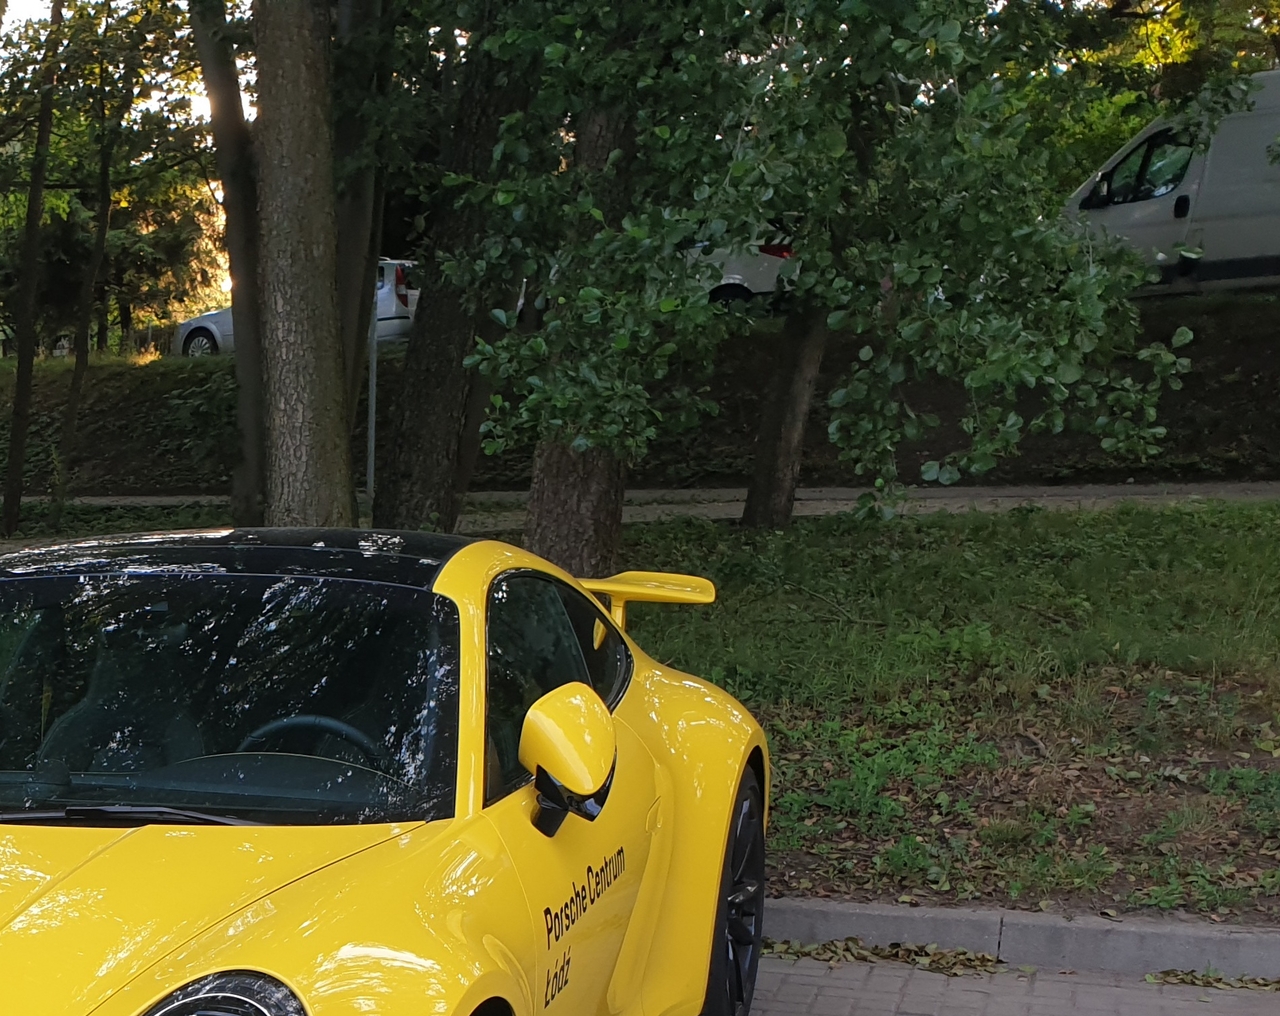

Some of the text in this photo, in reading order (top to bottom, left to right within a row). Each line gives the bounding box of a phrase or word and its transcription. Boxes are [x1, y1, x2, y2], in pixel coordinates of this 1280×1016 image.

[543, 846, 625, 951] Porsche Centrum
[544, 945, 571, 1009] Łódź
